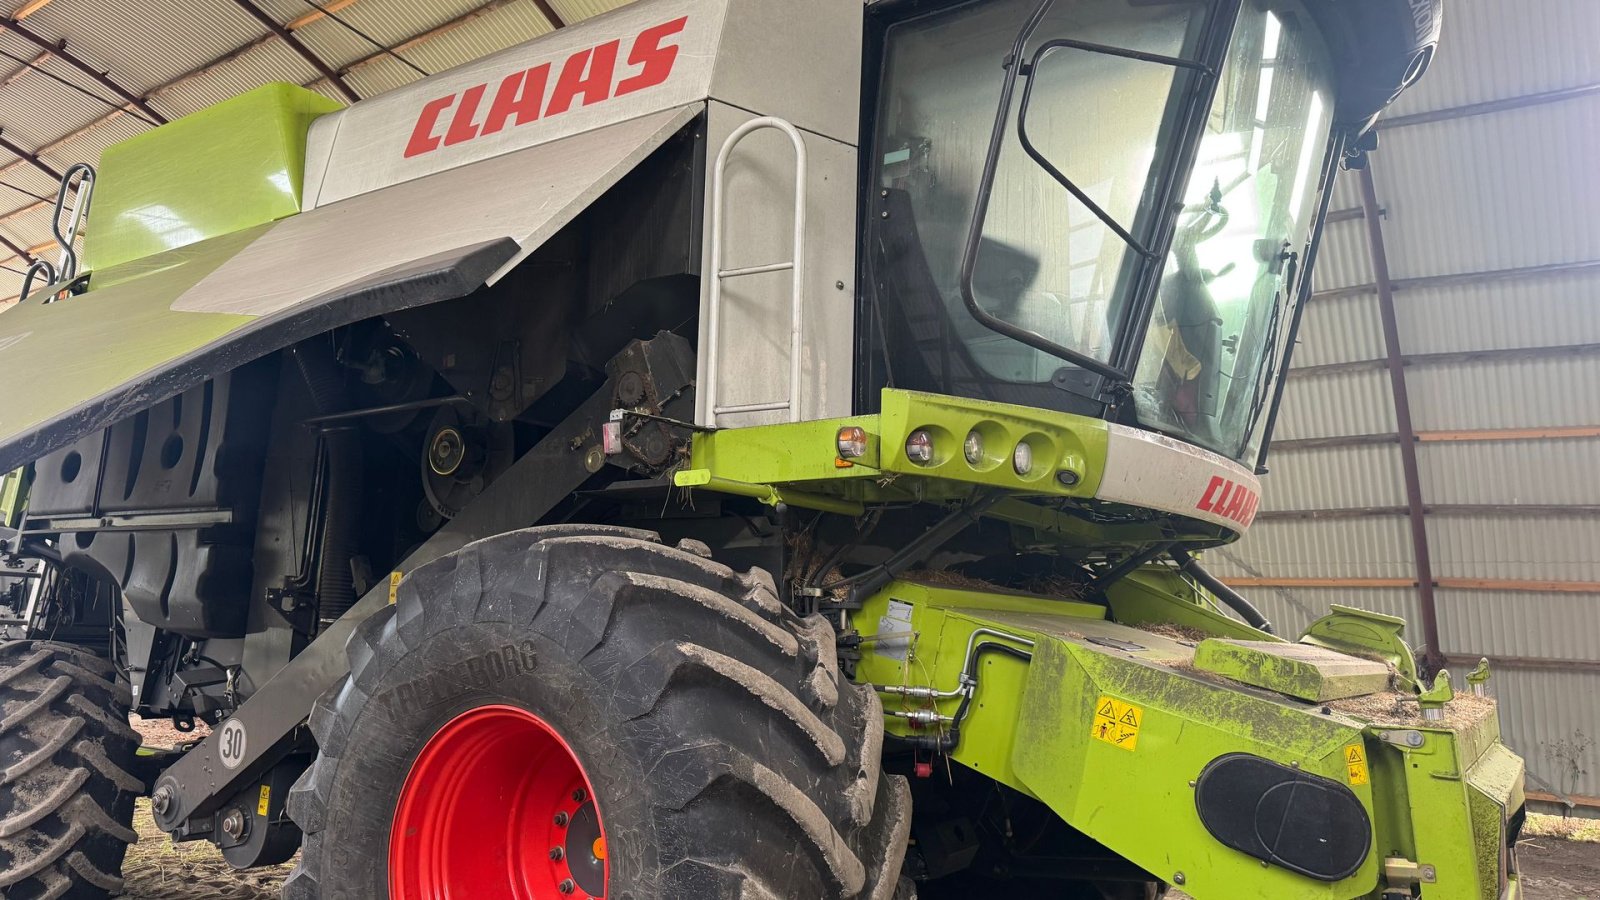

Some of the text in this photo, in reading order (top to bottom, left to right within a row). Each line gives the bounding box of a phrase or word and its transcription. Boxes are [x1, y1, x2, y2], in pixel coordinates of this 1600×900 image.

[1408, 0, 1433, 41] XION
[404, 16, 688, 157] CLAAS
[222, 727, 243, 760] 30
